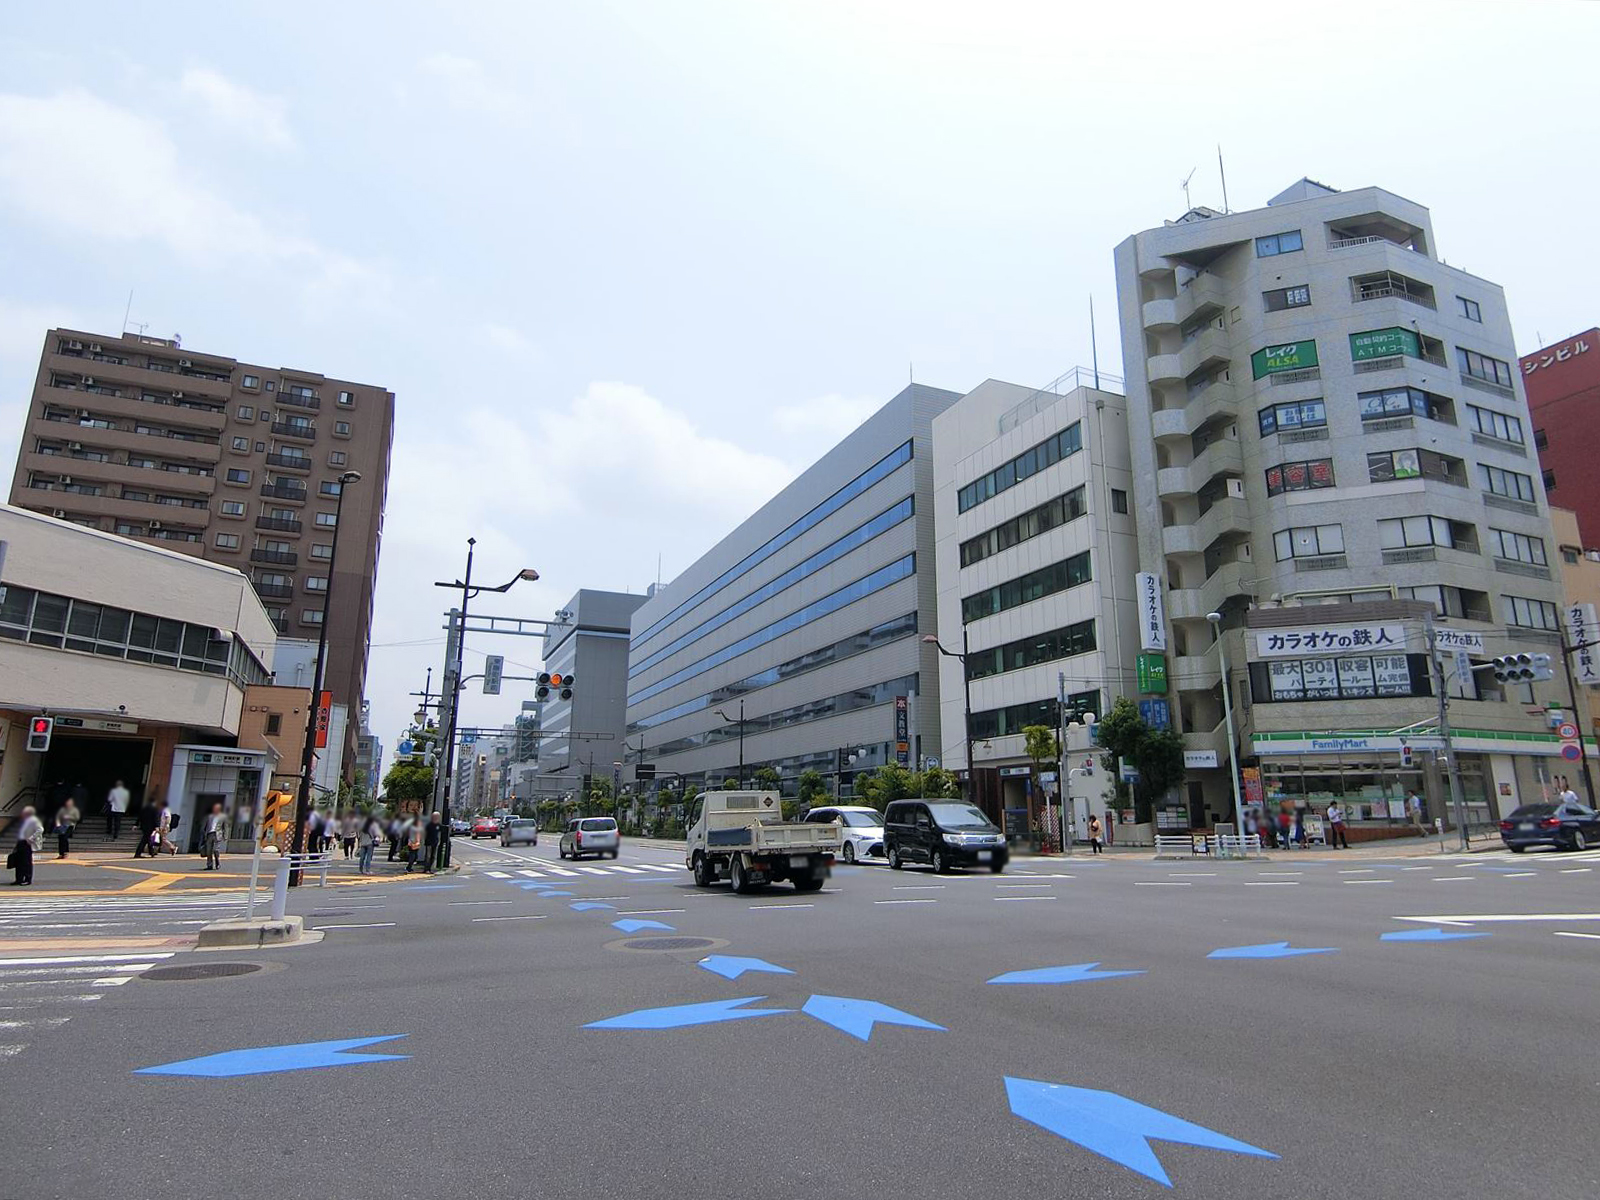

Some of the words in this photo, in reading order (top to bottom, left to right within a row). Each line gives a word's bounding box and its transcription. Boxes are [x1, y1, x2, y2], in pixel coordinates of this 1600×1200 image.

[1266, 345, 1296, 358] レイク
[1267, 354, 1299, 367] ALSA
[1524, 341, 1589, 374] シンビル
[1268, 464, 1331, 487] 美容室
[1146, 575, 1160, 643] カラオケの鉄人
[1268, 627, 1393, 650] カラオケの鉄人
[1434, 631, 1482, 647] ラオケの鉄人
[1571, 608, 1595, 677] カラオケの鉄人
[1312, 739, 1368, 749] FamilyMart
